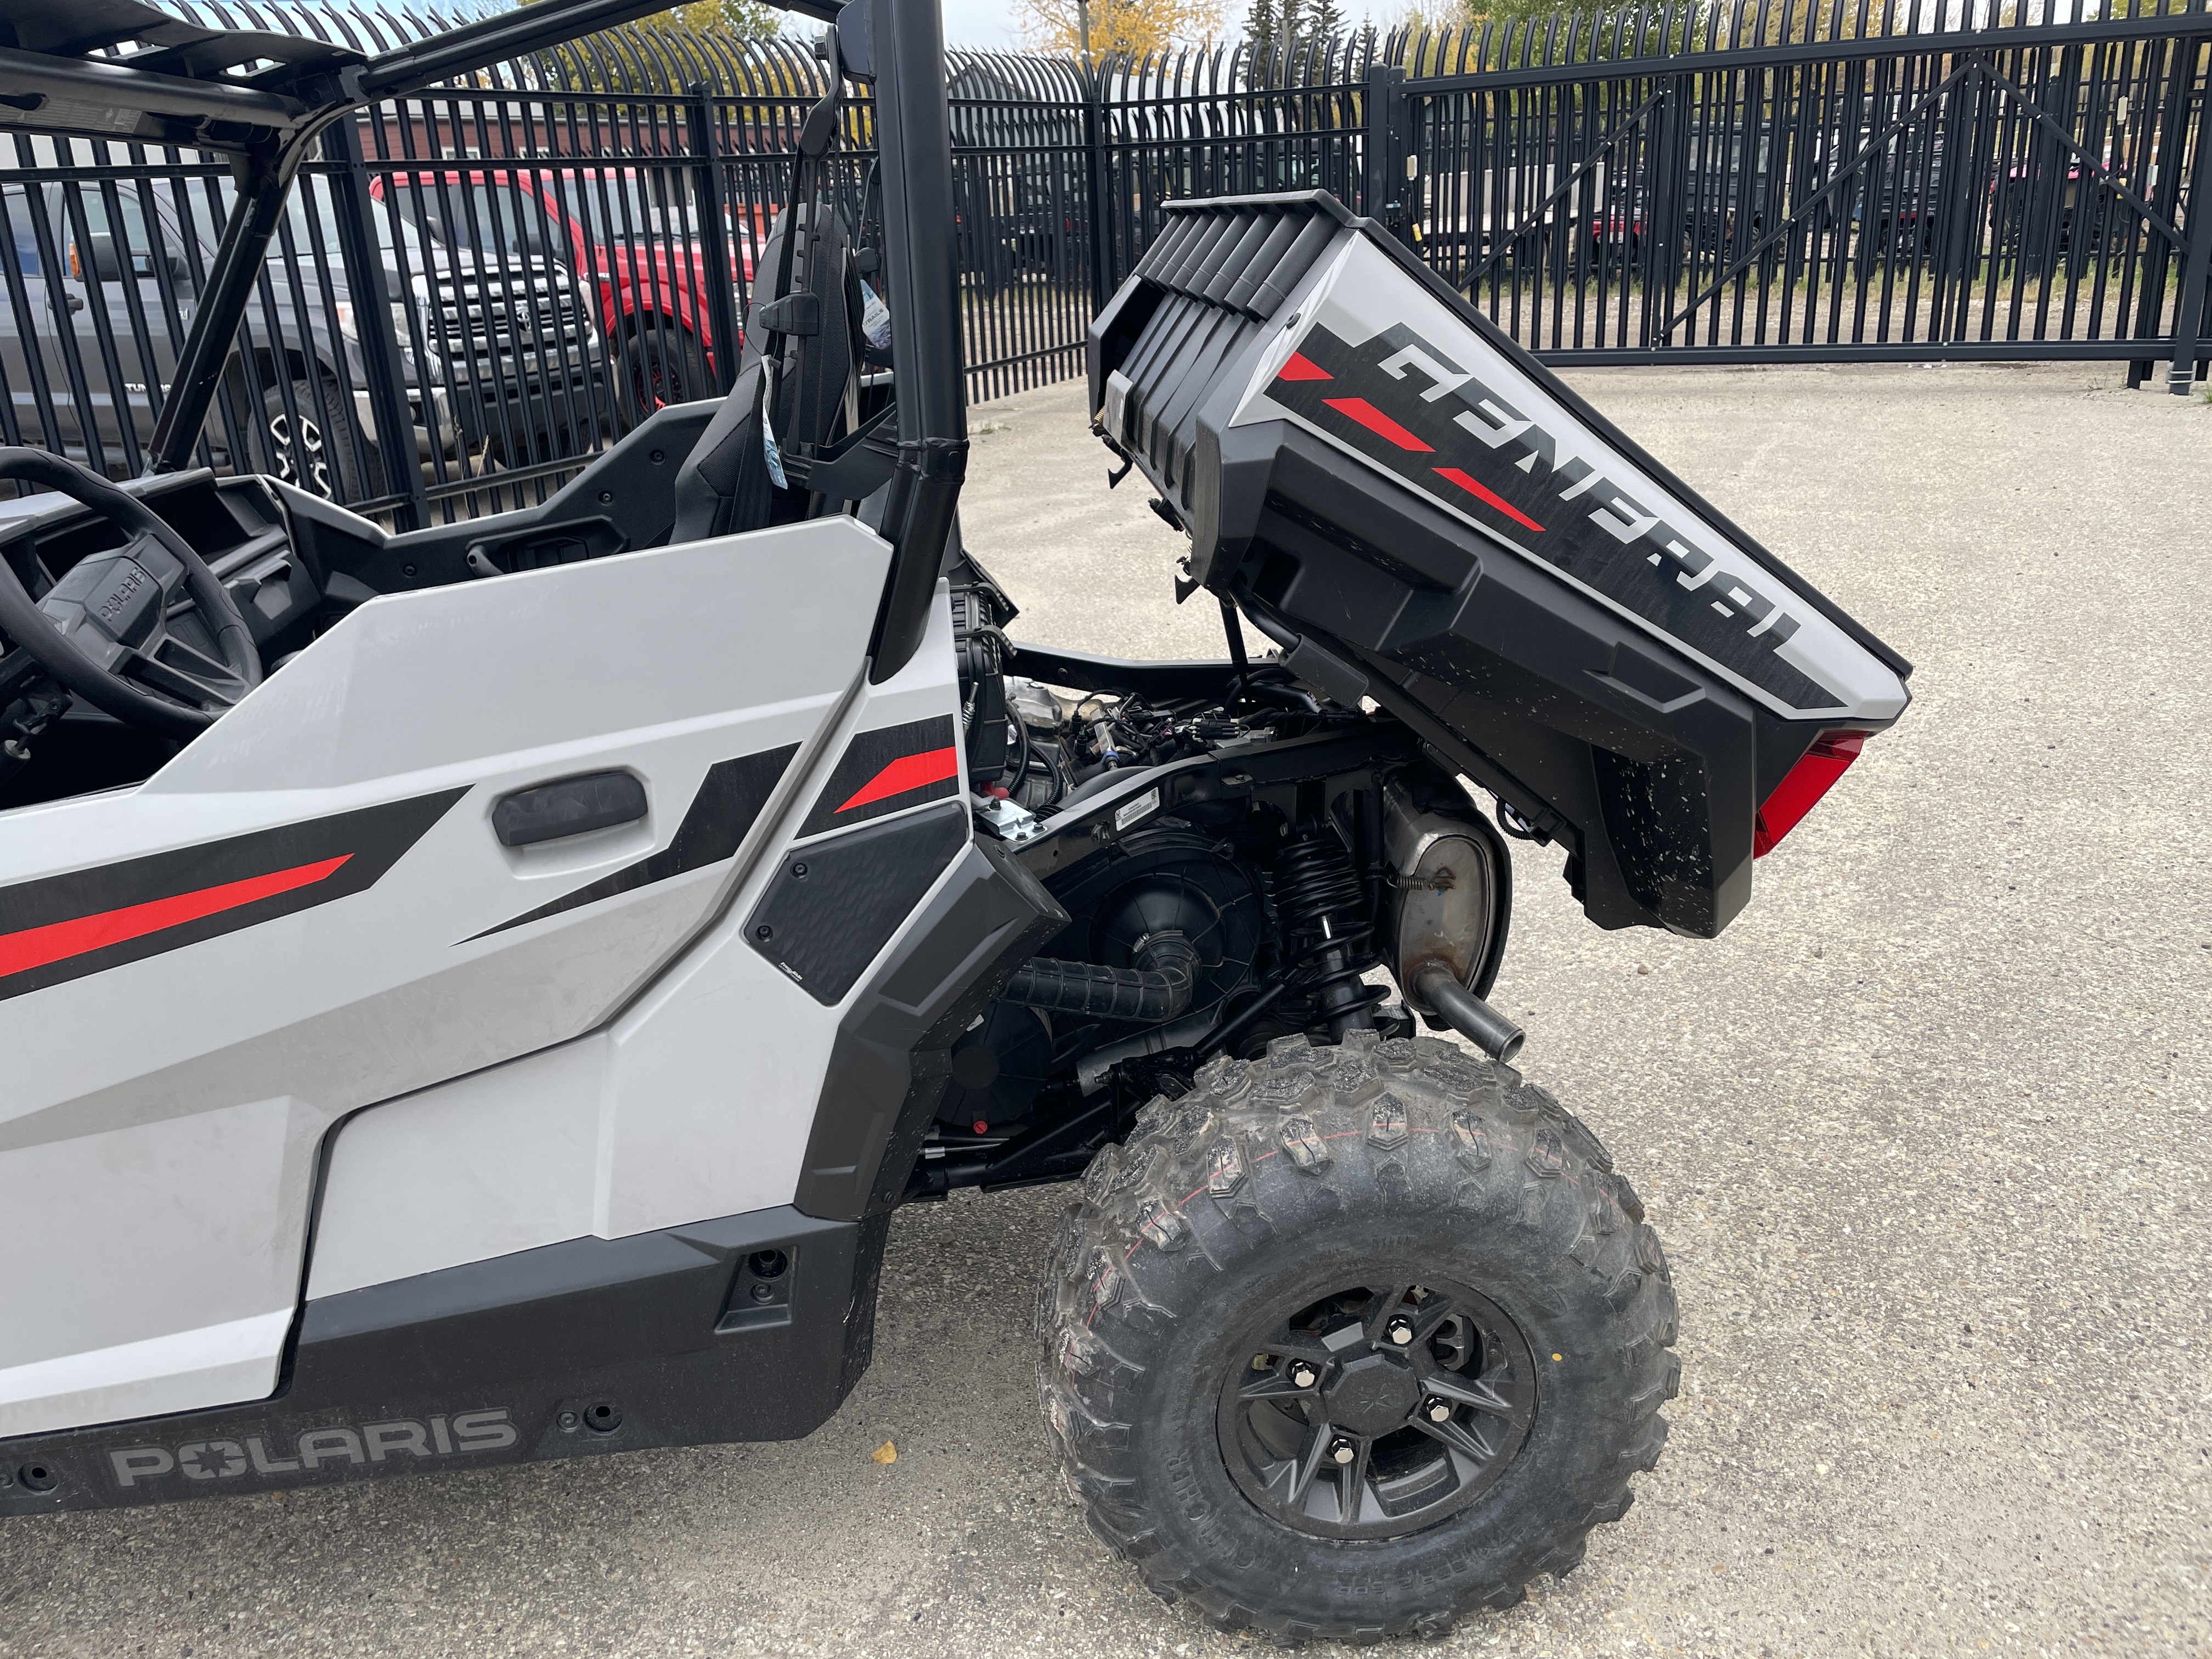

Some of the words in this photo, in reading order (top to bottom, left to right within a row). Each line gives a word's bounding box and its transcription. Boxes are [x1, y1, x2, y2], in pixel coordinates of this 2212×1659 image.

[1369, 321, 1815, 665] GENERAL
[98, 566, 146, 622] POLARIS
[110, 1410, 517, 1486] POLARIS
